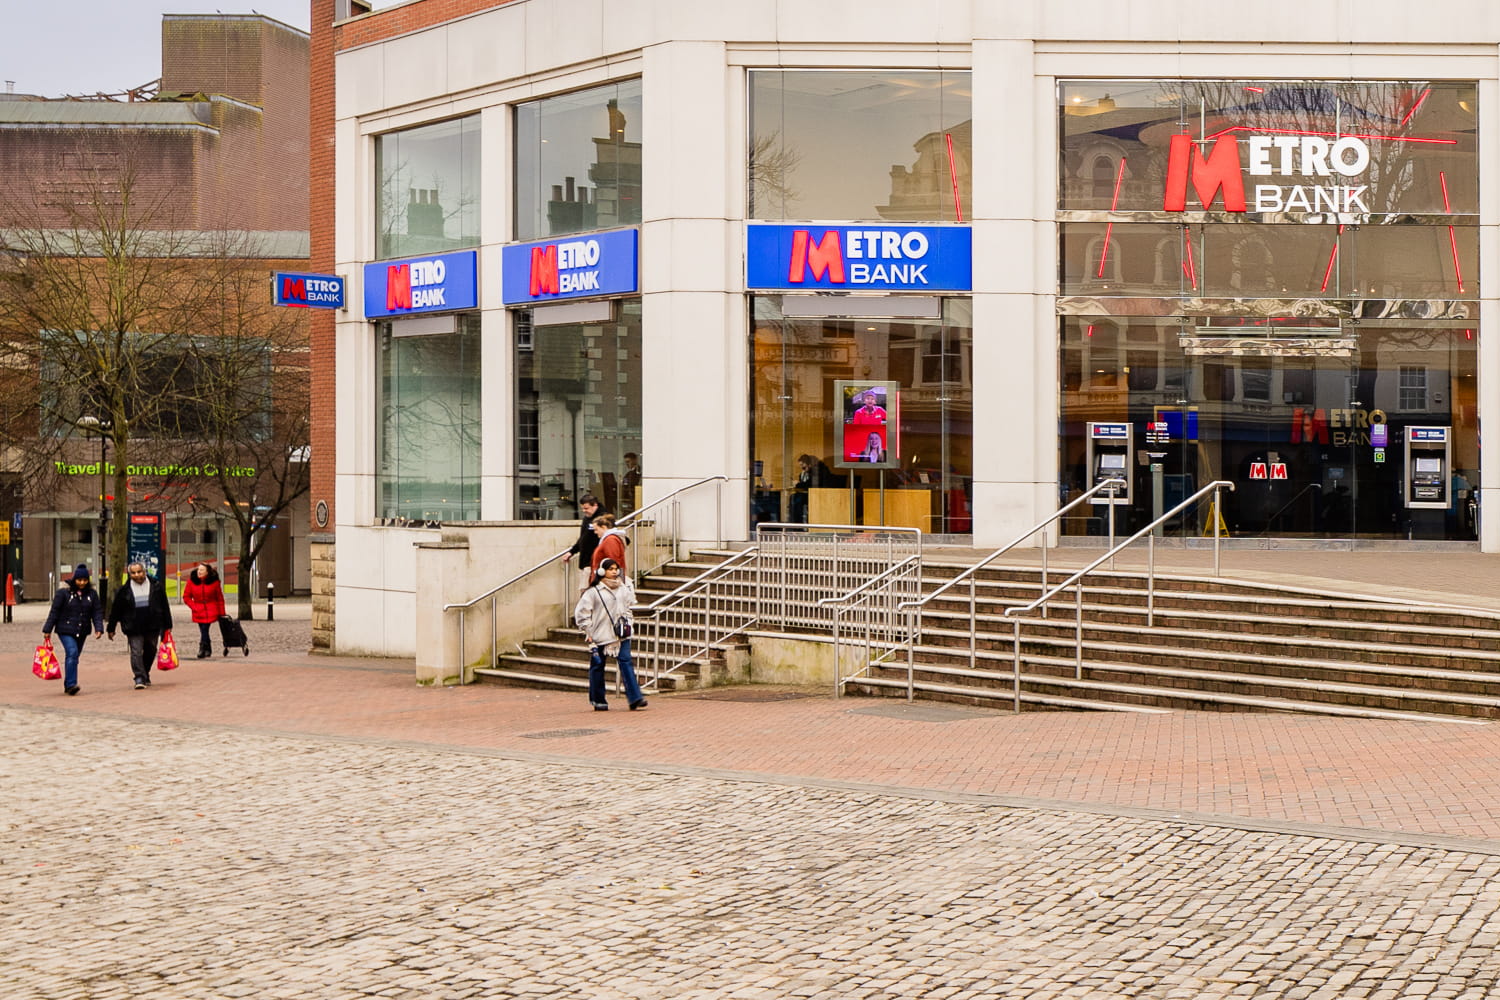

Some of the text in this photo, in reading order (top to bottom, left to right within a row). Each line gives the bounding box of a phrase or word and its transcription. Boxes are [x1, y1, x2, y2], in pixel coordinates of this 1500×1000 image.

[1163, 134, 1370, 212] METRO
[1255, 184, 1370, 213] BANK
[529, 239, 600, 296] METRO
[788, 230, 929, 283] METRO
[386, 259, 446, 310] METRO
[559, 270, 600, 293] BANK
[850, 263, 928, 284] BANK
[283, 278, 340, 300] METRO
[307, 292, 340, 302] BANK
[411, 287, 446, 308] BANK
[1290, 408, 1387, 444] METRO
[1333, 431, 1372, 446] BAN
[54, 461, 255, 477] Travel Inormation Cntre
